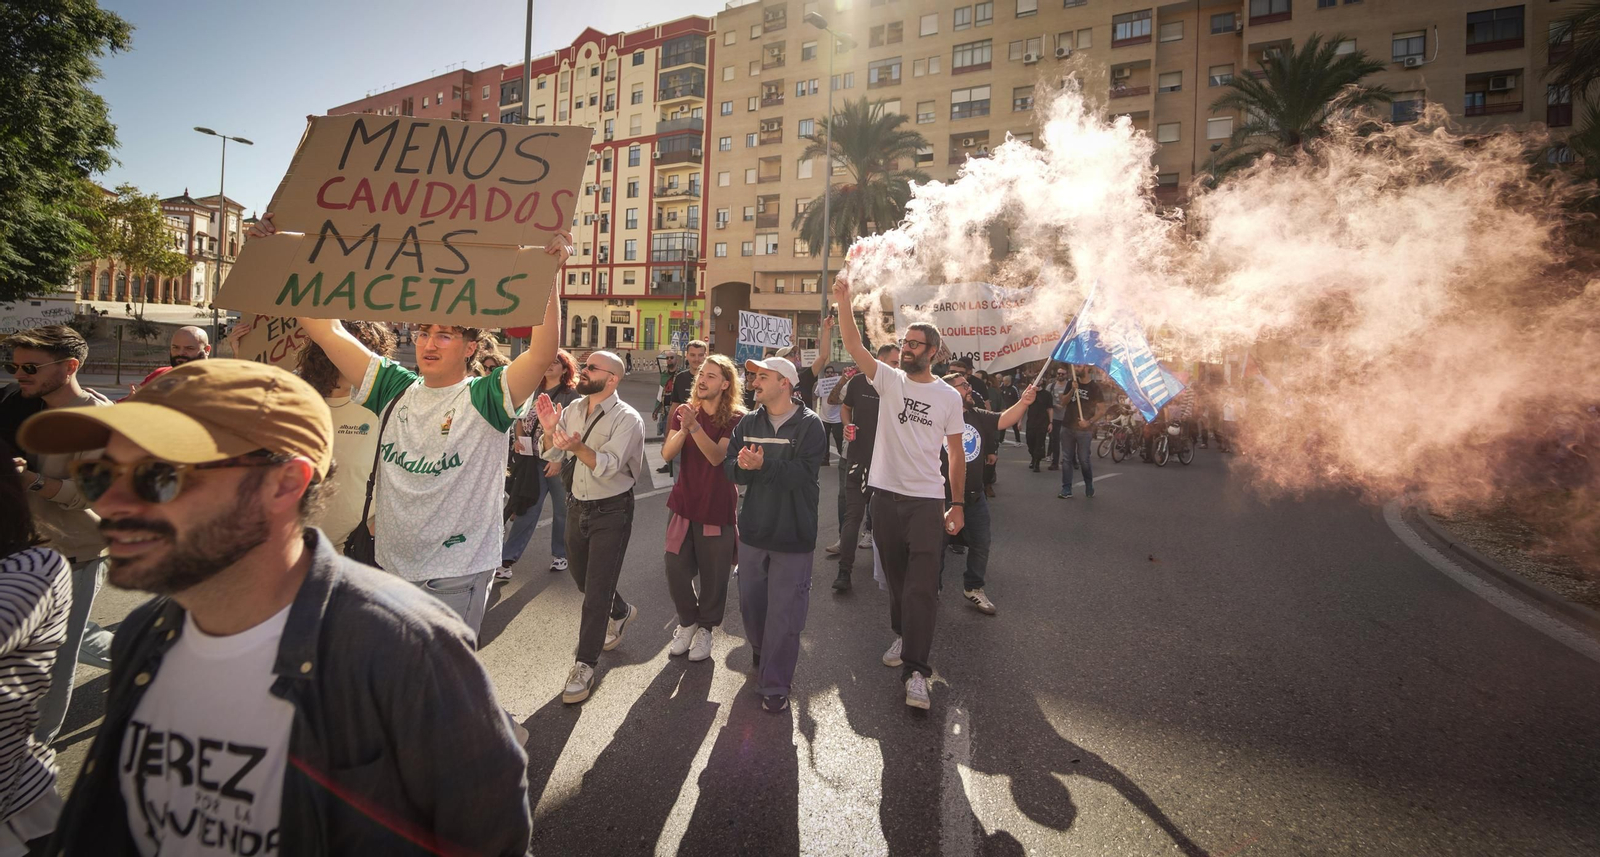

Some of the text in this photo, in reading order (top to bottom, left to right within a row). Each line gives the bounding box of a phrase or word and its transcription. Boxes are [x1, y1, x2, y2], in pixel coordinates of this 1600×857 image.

[338, 118, 560, 185] MENOS
[316, 176, 574, 232] CANDADOS
[308, 219, 478, 275] MÁS
[274, 271, 528, 316] MACETAS
[914, 301, 966, 312] ACBARON
[968, 300, 988, 310] LAS
[740, 327, 790, 347] SIN CASAS
[741, 312, 792, 334] NOS DEJAN
[124, 720, 268, 805] JEREZ
